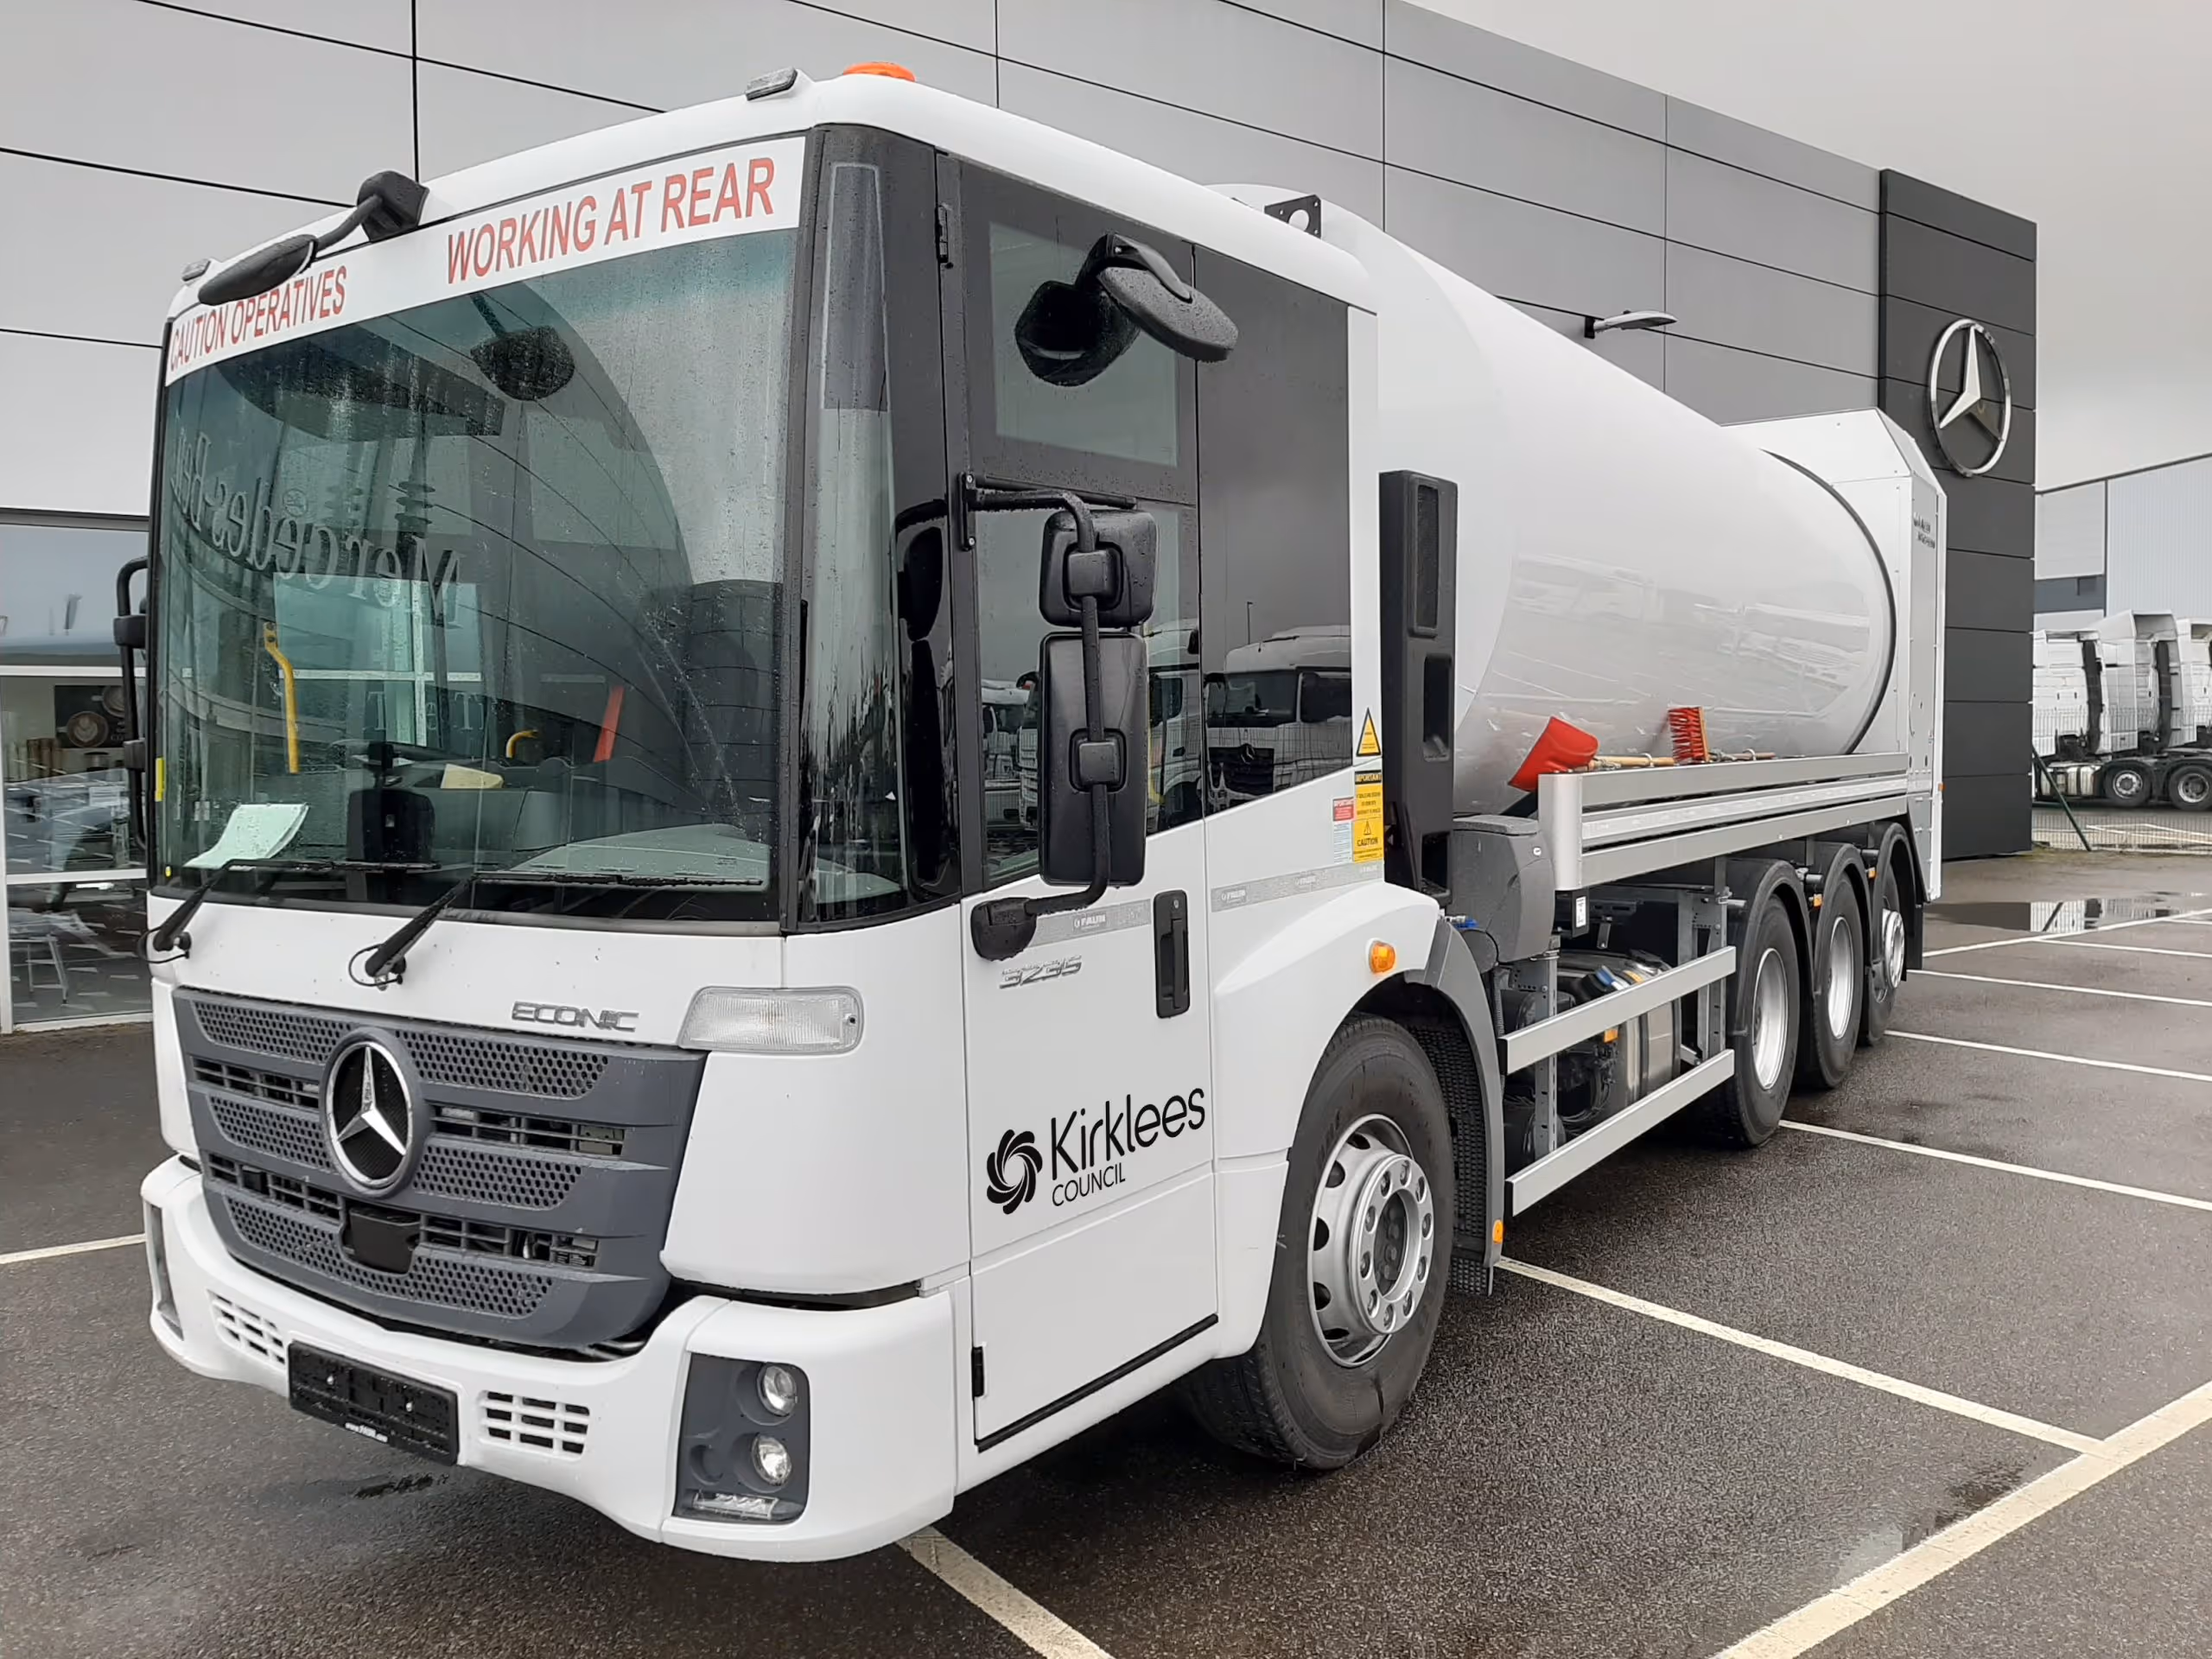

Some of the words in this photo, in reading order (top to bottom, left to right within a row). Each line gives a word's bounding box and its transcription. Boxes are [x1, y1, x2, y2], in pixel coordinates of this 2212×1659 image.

[170, 304, 229, 372] CAUTION
[231, 265, 346, 345] OPERATIVES
[448, 195, 596, 284] WORKING
[604, 181, 652, 245] AT
[661, 157, 775, 232] REAR
[512, 1001, 639, 1032] ECONIC
[1051, 1088, 1205, 1180] Kirklees
[1052, 1162, 1126, 1206] COUNCIL
